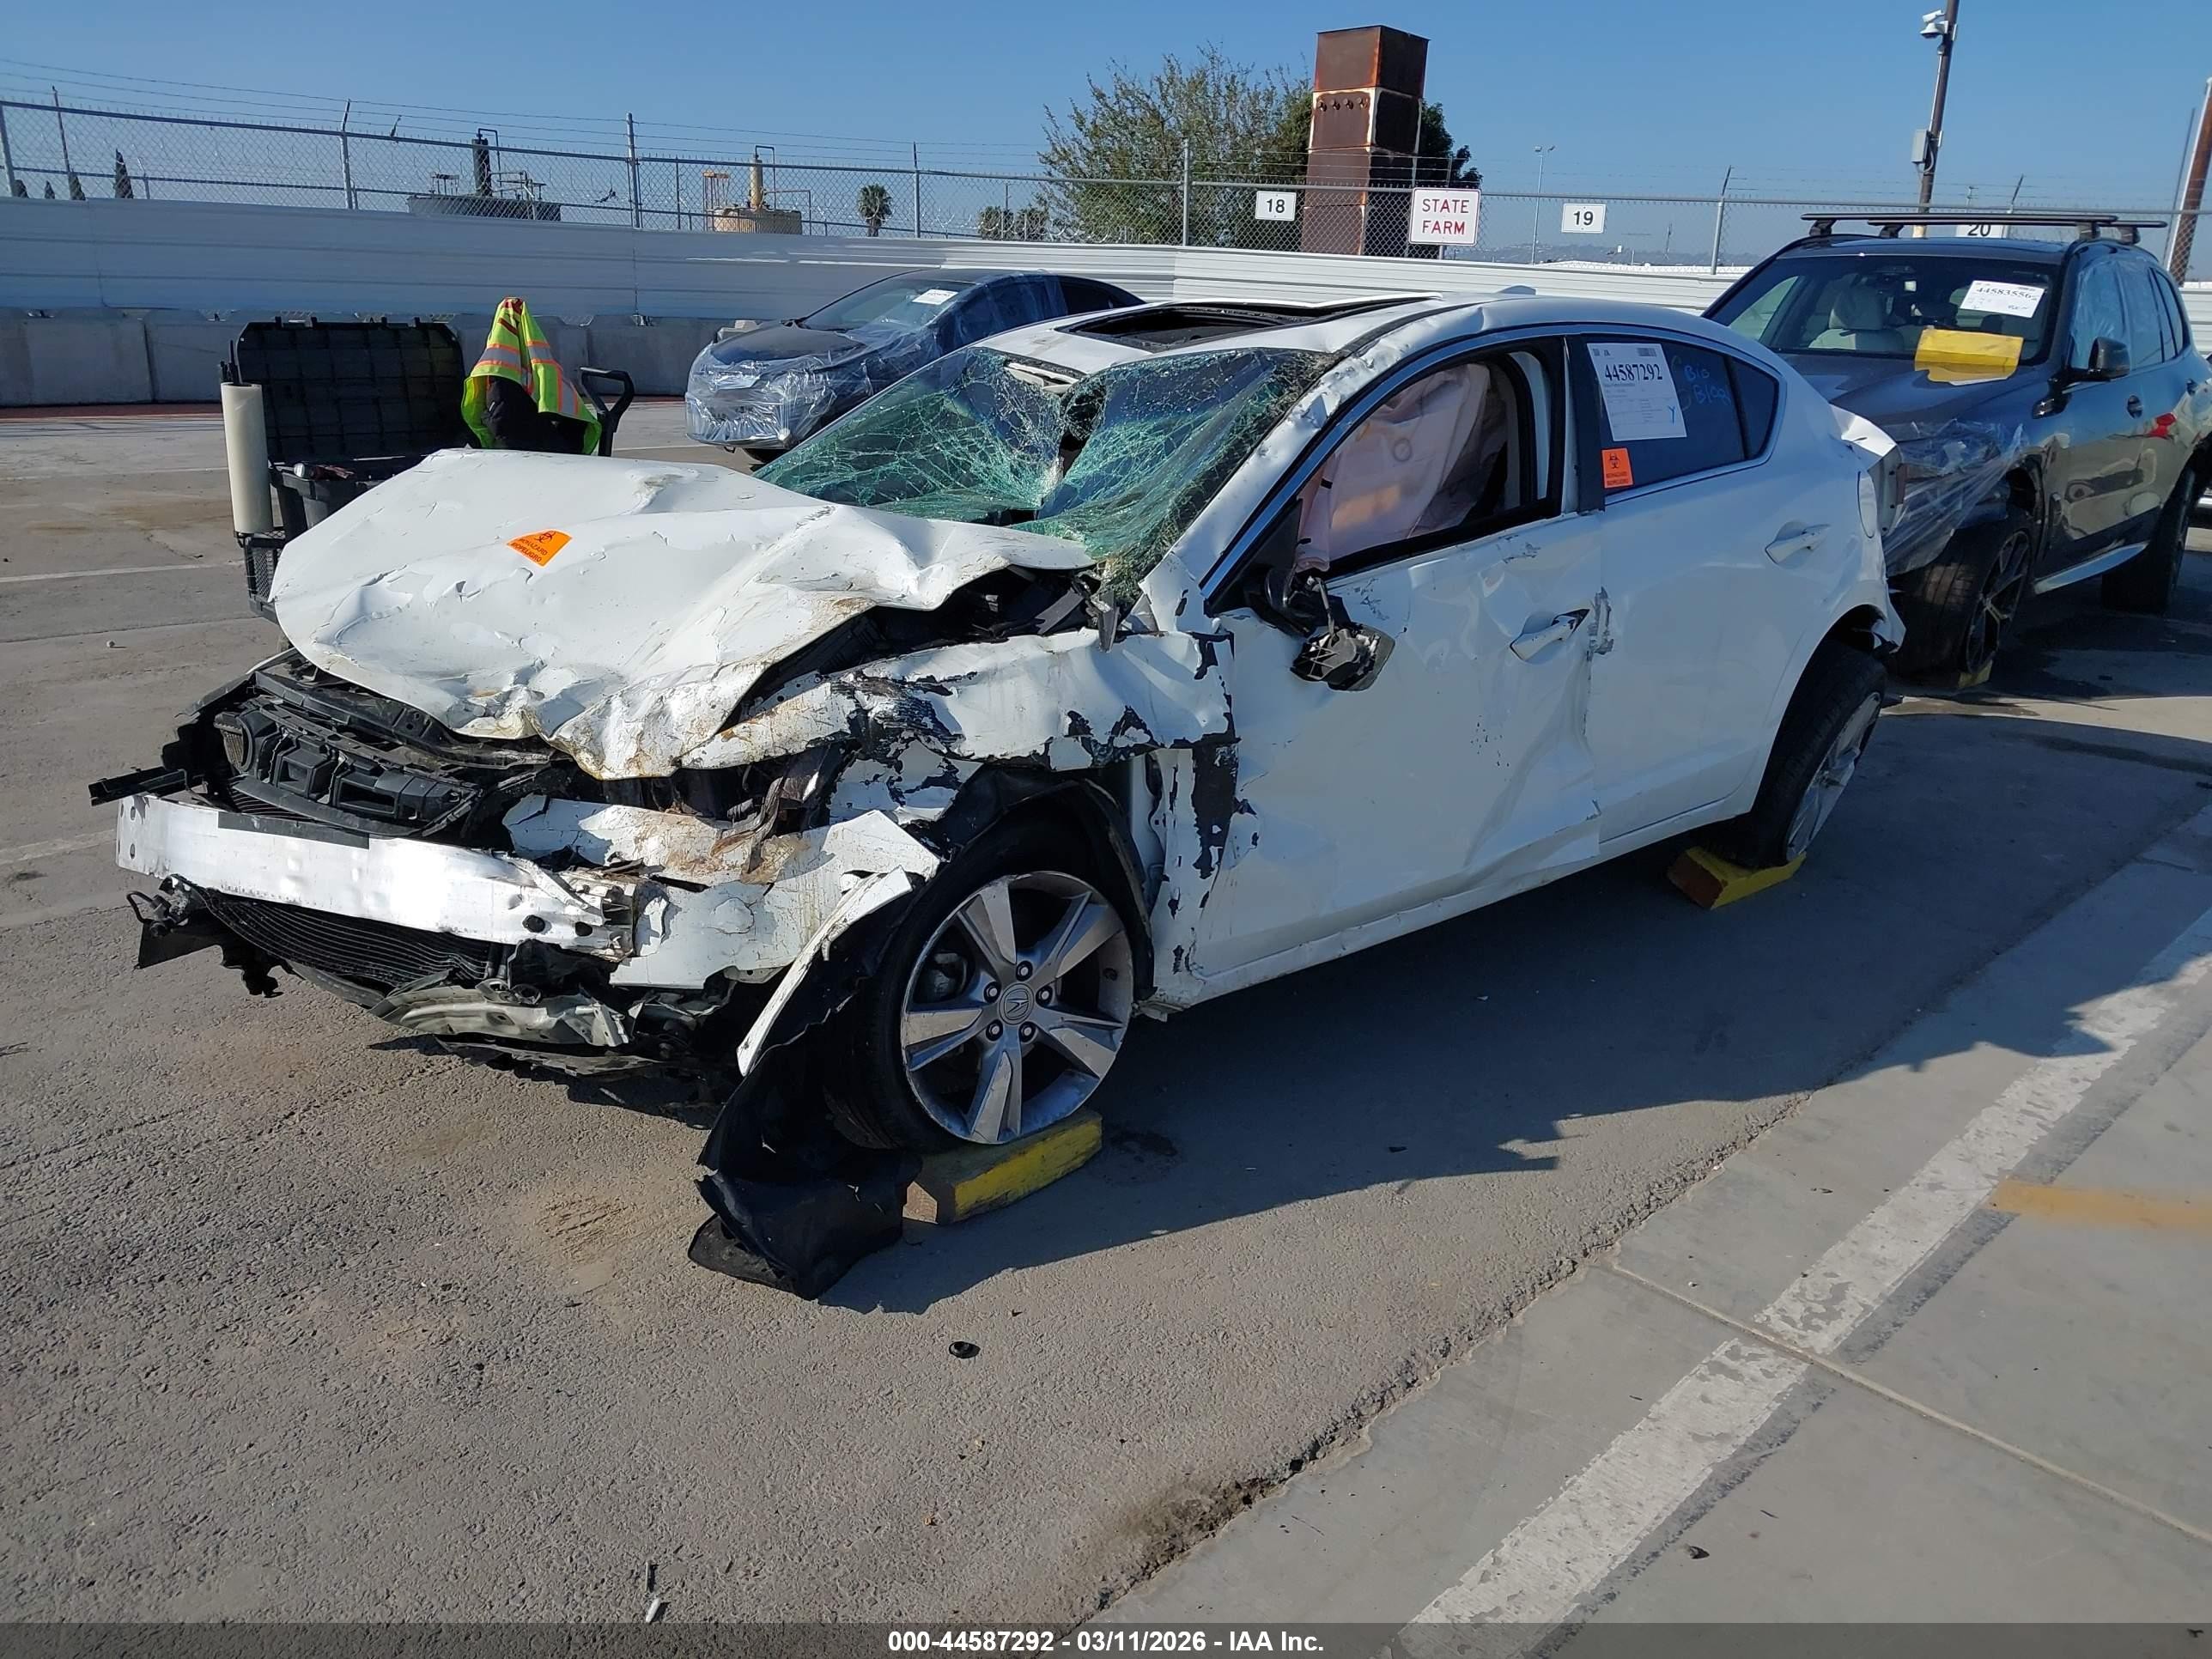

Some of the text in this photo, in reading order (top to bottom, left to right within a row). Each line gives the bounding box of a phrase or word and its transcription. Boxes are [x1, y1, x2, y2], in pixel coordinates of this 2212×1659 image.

[1267, 198, 1285, 213] 18
[1422, 198, 1469, 213] STATE
[1573, 210, 1594, 226] 19
[1422, 220, 1465, 234] FARM
[1967, 224, 1991, 236] 20
[1605, 363, 1662, 381] 44587292
